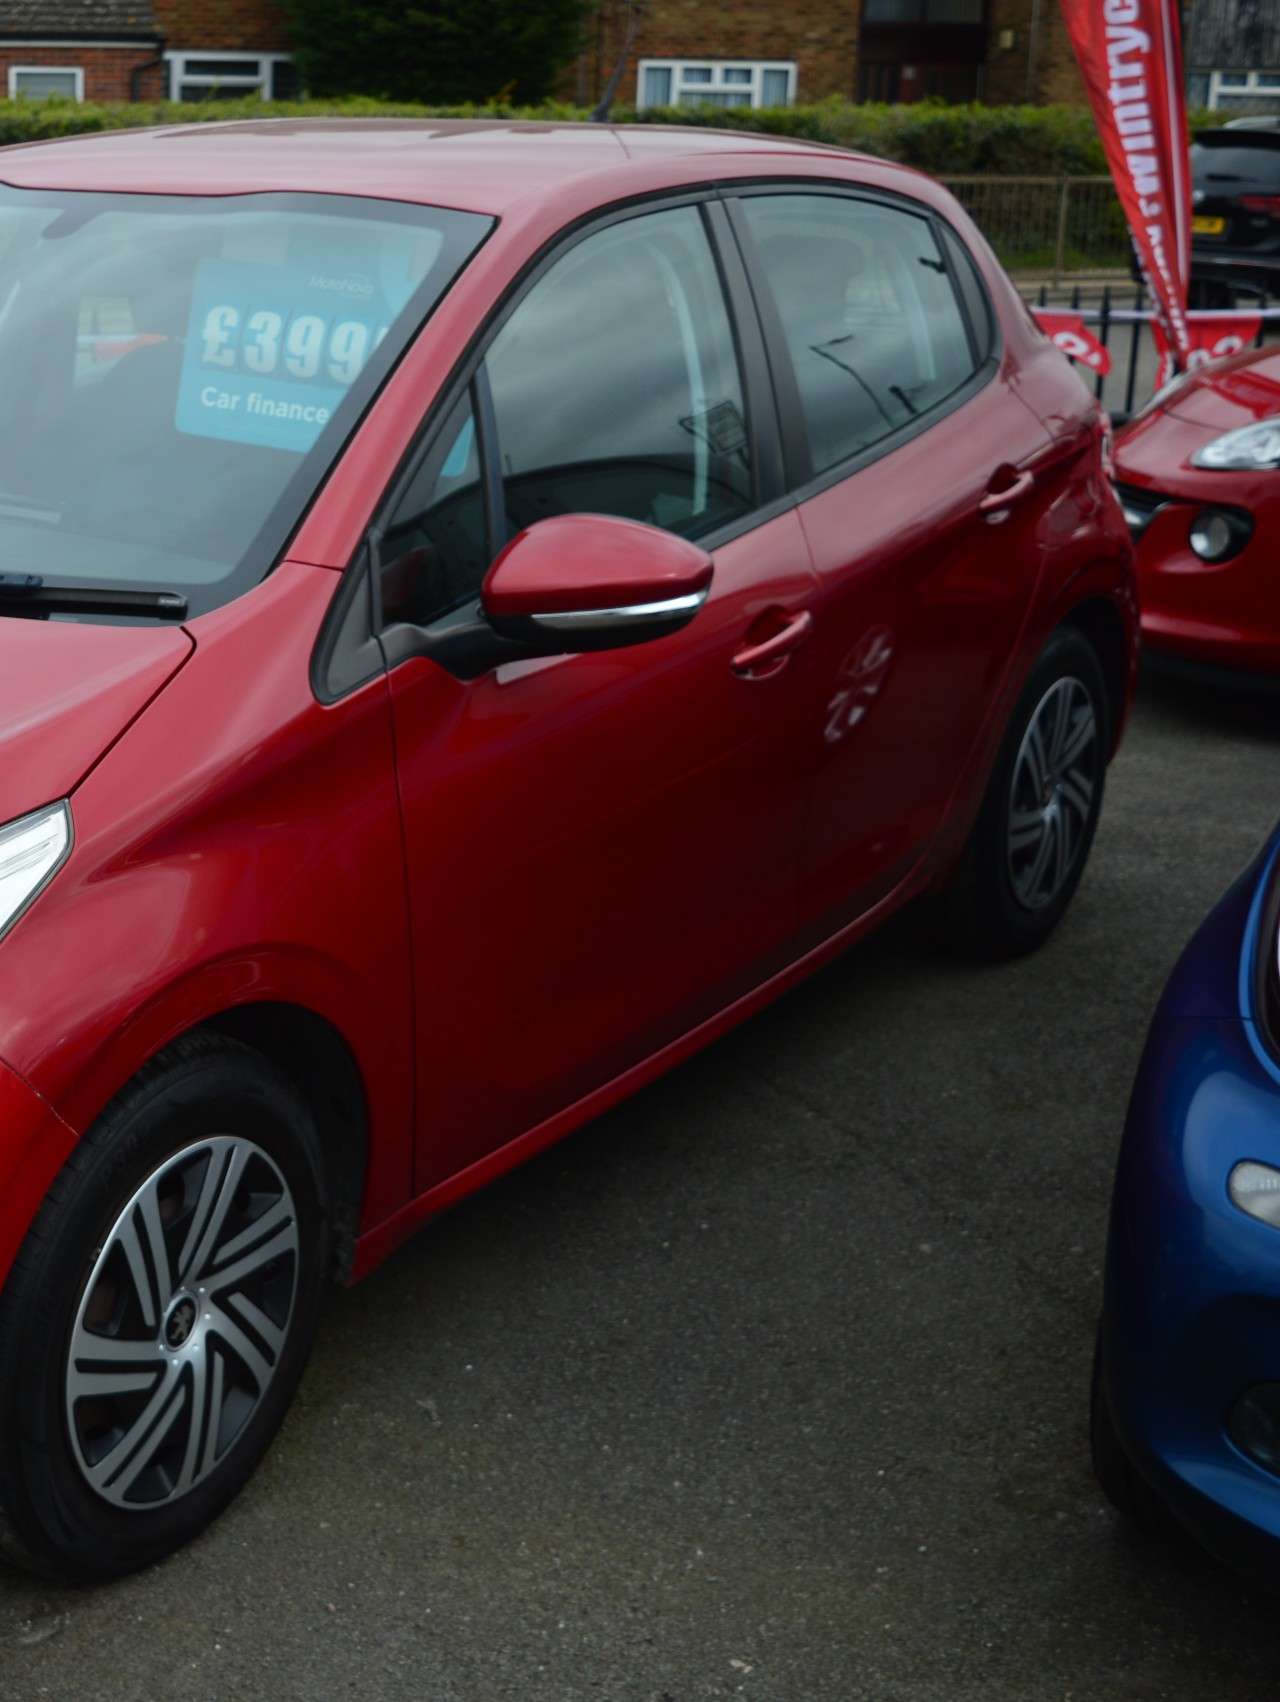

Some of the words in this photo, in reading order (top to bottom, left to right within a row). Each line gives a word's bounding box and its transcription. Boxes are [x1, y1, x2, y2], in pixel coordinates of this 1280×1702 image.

[202, 304, 389, 385] £399
[201, 386, 241, 411] Car
[246, 392, 330, 425] finance
